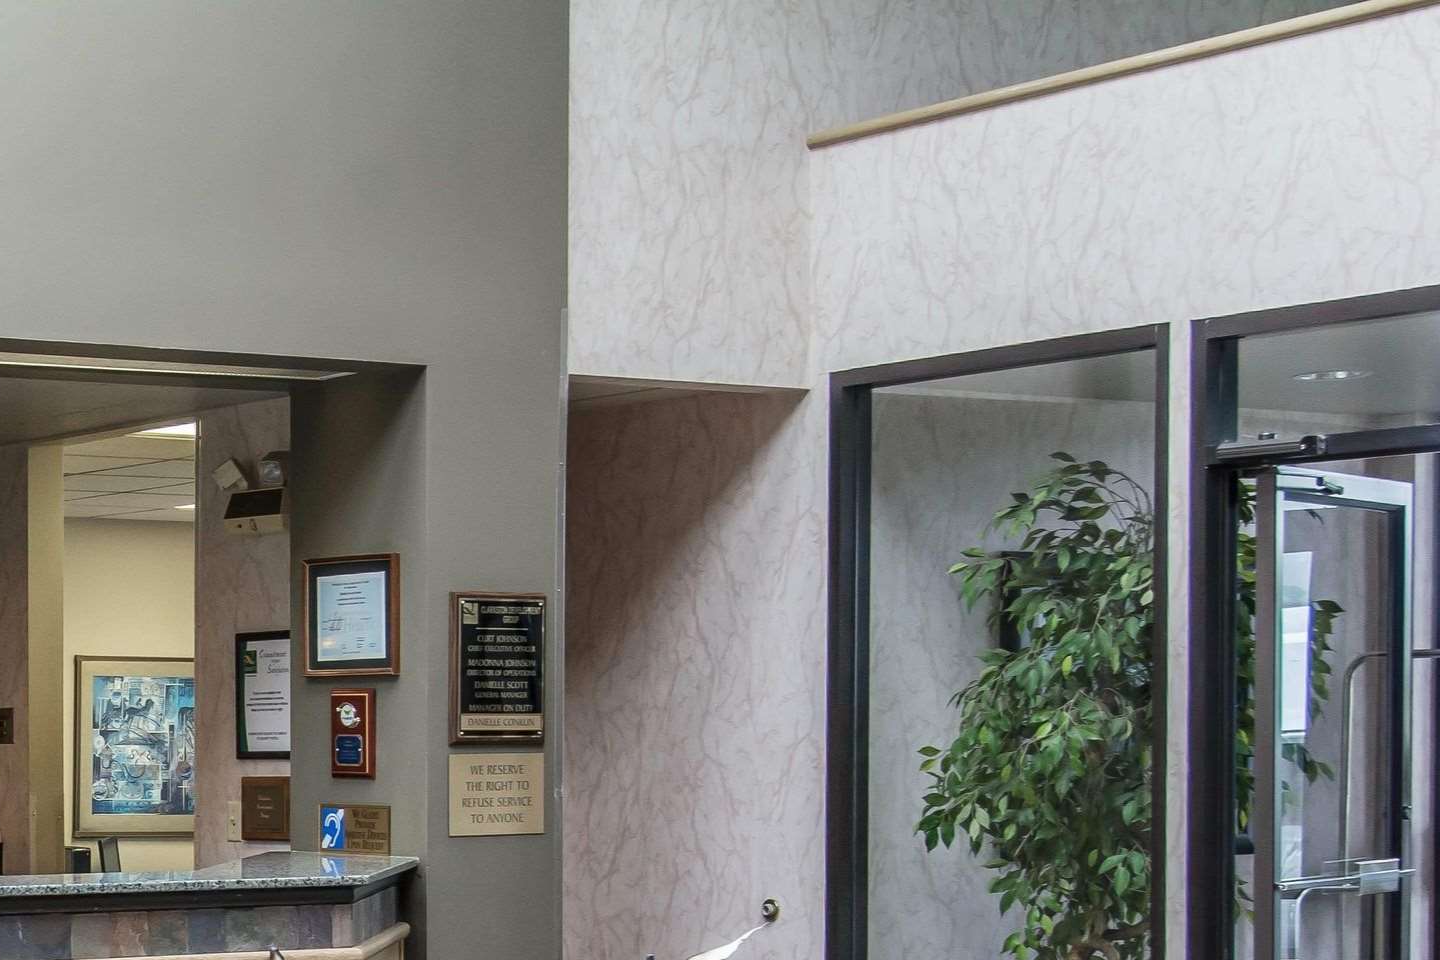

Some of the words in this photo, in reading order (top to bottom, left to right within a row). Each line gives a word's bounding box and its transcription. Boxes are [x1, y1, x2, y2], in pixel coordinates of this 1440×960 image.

[470, 765, 484, 775] WE
[486, 764, 526, 775] RESERVE
[465, 781, 485, 792] THE
[486, 780, 514, 791] RIGHT
[517, 780, 530, 790] TO
[462, 797, 495, 808] REFUSE
[497, 796, 534, 807] SERVICE
[471, 813, 484, 824] TO
[486, 813, 525, 823] ANYONE
